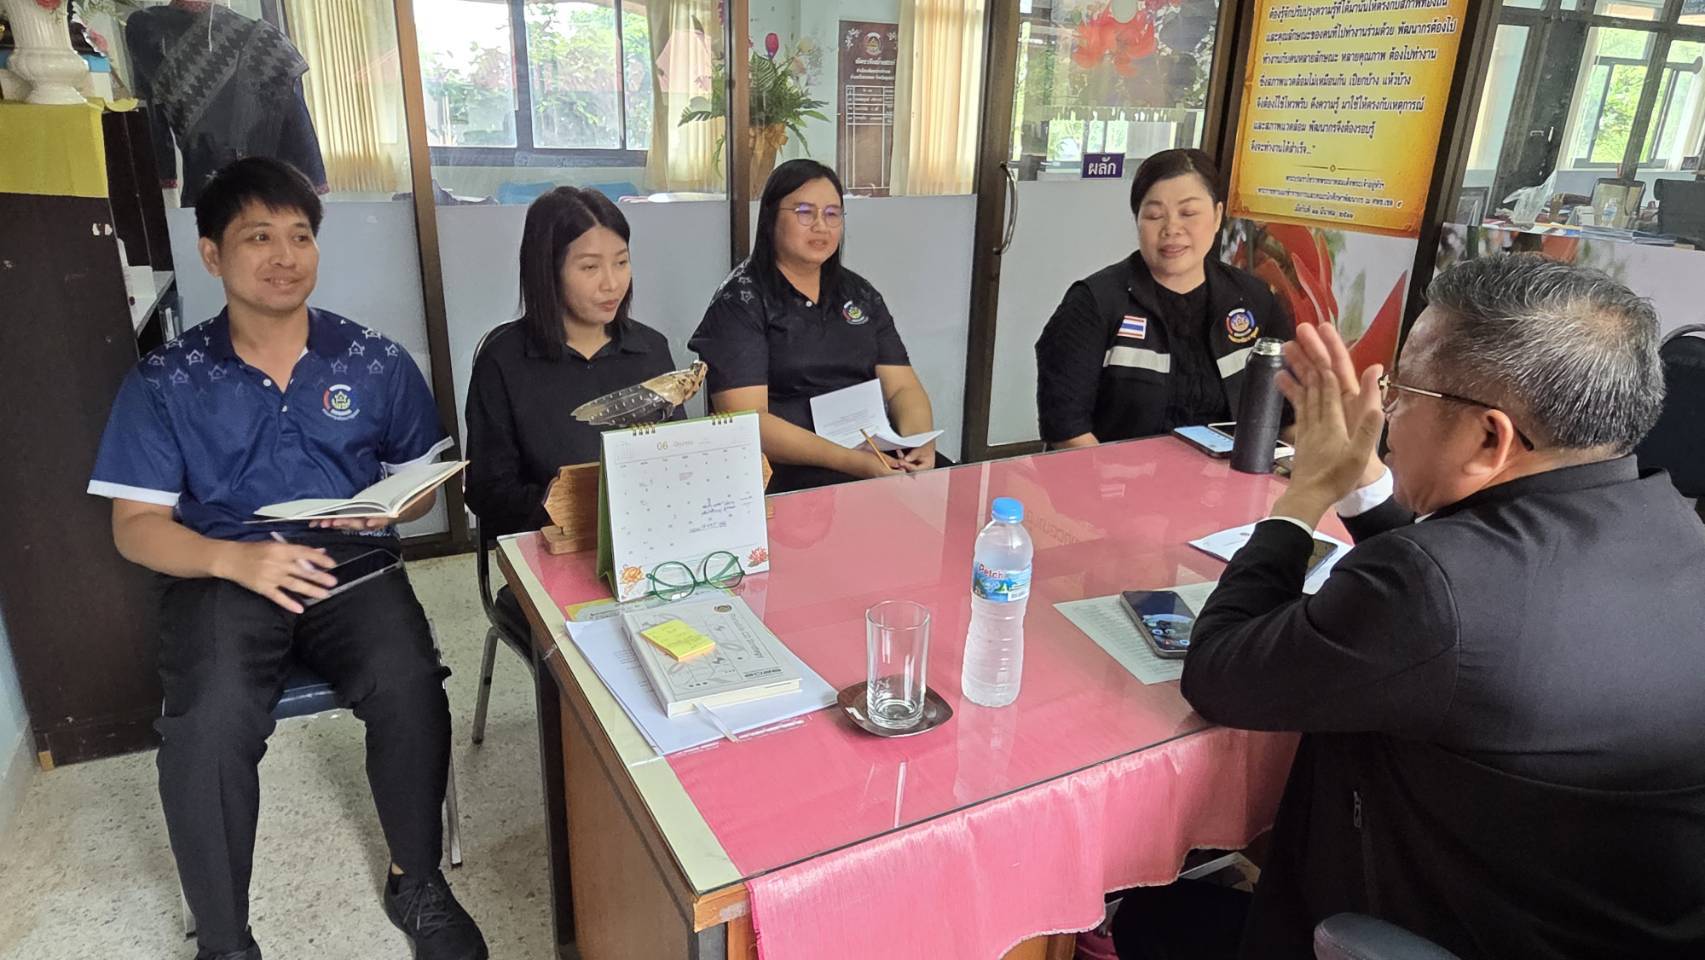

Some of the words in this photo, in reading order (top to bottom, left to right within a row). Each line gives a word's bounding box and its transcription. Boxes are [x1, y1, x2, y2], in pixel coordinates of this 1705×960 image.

[1398, 16, 1457, 34] พัฒนากรต้องไป
[1088, 156, 1117, 175] ผลัก
